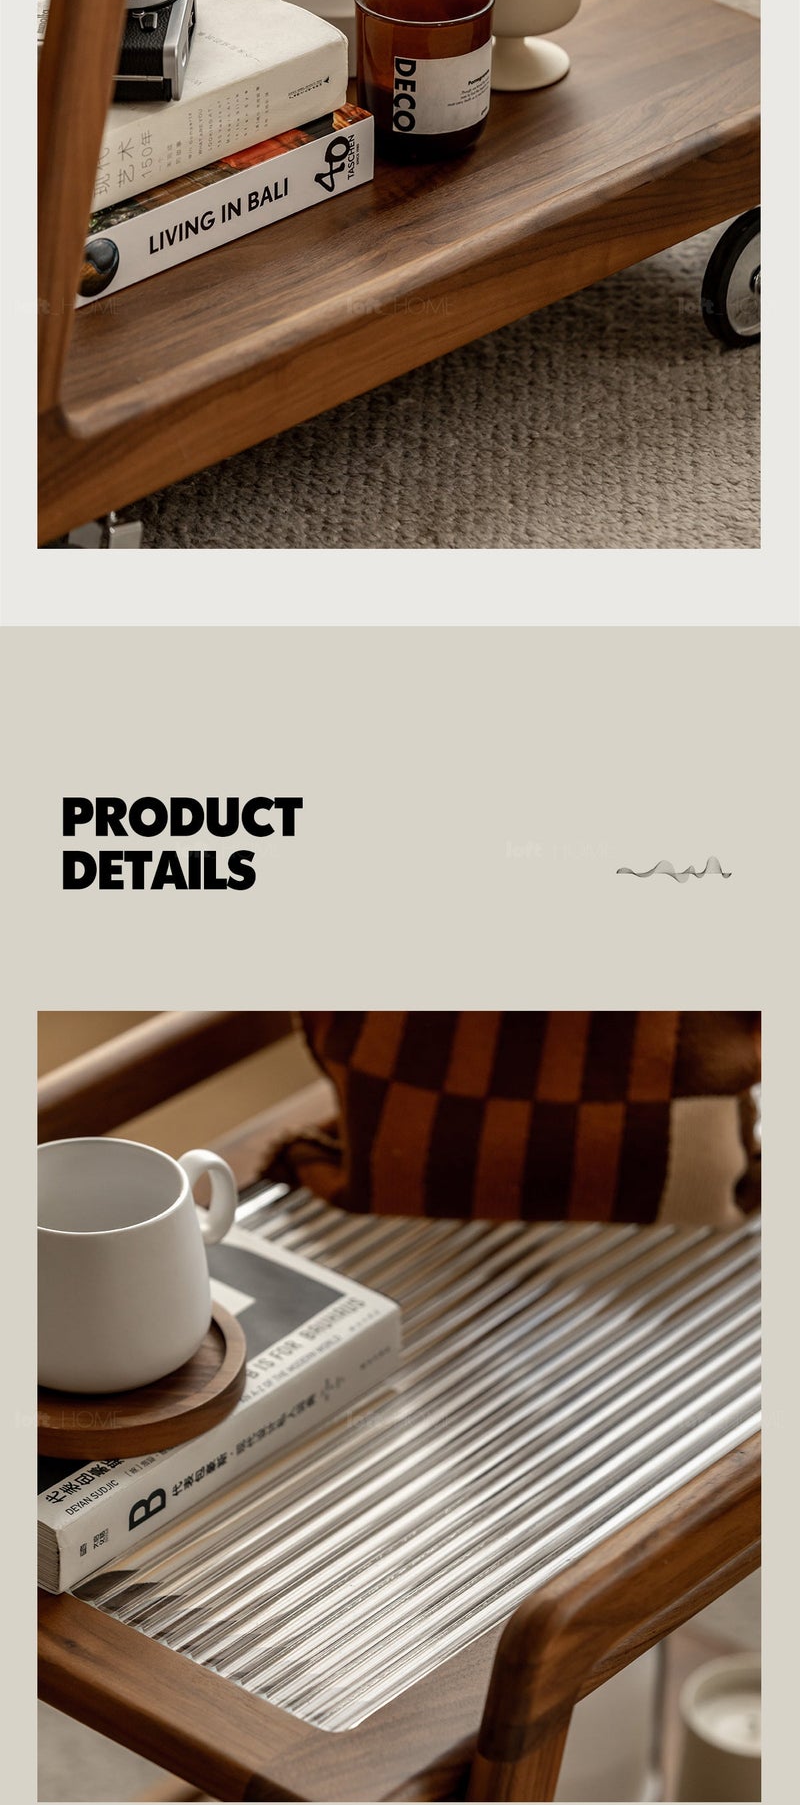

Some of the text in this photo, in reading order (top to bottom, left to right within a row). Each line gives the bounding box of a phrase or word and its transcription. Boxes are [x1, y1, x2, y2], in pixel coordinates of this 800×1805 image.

[393, 58, 416, 132] DECO
[149, 177, 289, 255] LIVING IN BALI
[253, 1357, 275, 1371] IS
[270, 1339, 300, 1360] FOR
[65, 1479, 119, 1515] DEYAN SUDJIC
[129, 1488, 166, 1531] B
